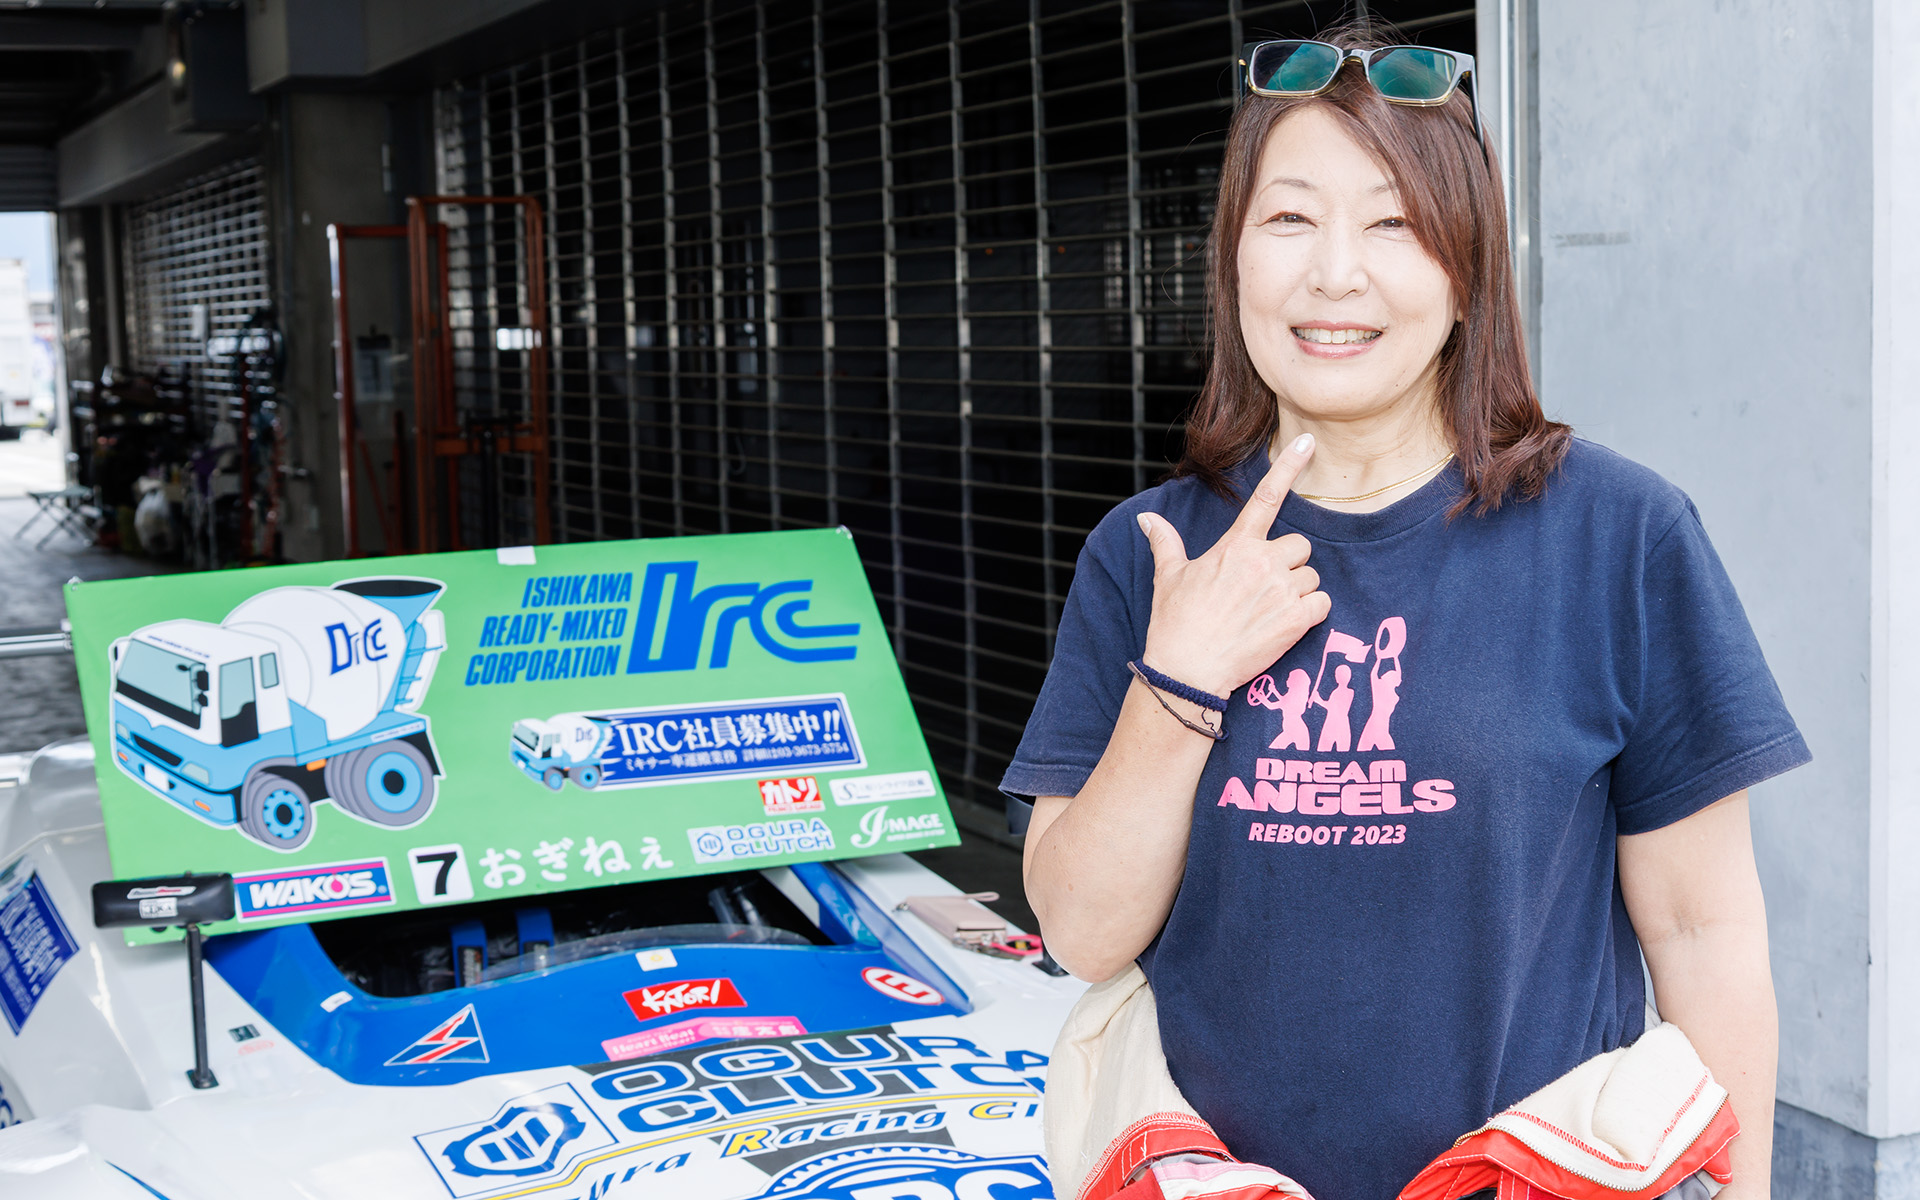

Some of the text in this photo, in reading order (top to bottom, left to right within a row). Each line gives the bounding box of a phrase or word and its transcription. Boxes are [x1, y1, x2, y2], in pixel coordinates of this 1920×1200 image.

[521, 572, 633, 609] ISHIKAWA
[478, 607, 629, 648] READY-MIXED
[464, 644, 622, 687] CORPORATION
[1255, 758, 1407, 784] DREAM
[1217, 776, 1457, 816] ANGELS
[726, 820, 828, 842] OGURA
[731, 836, 832, 857] CLUTCH
[1248, 822, 1407, 846] REBOOT 2023
[416, 851, 458, 896] 7
[719, 1108, 947, 1157] Racing
